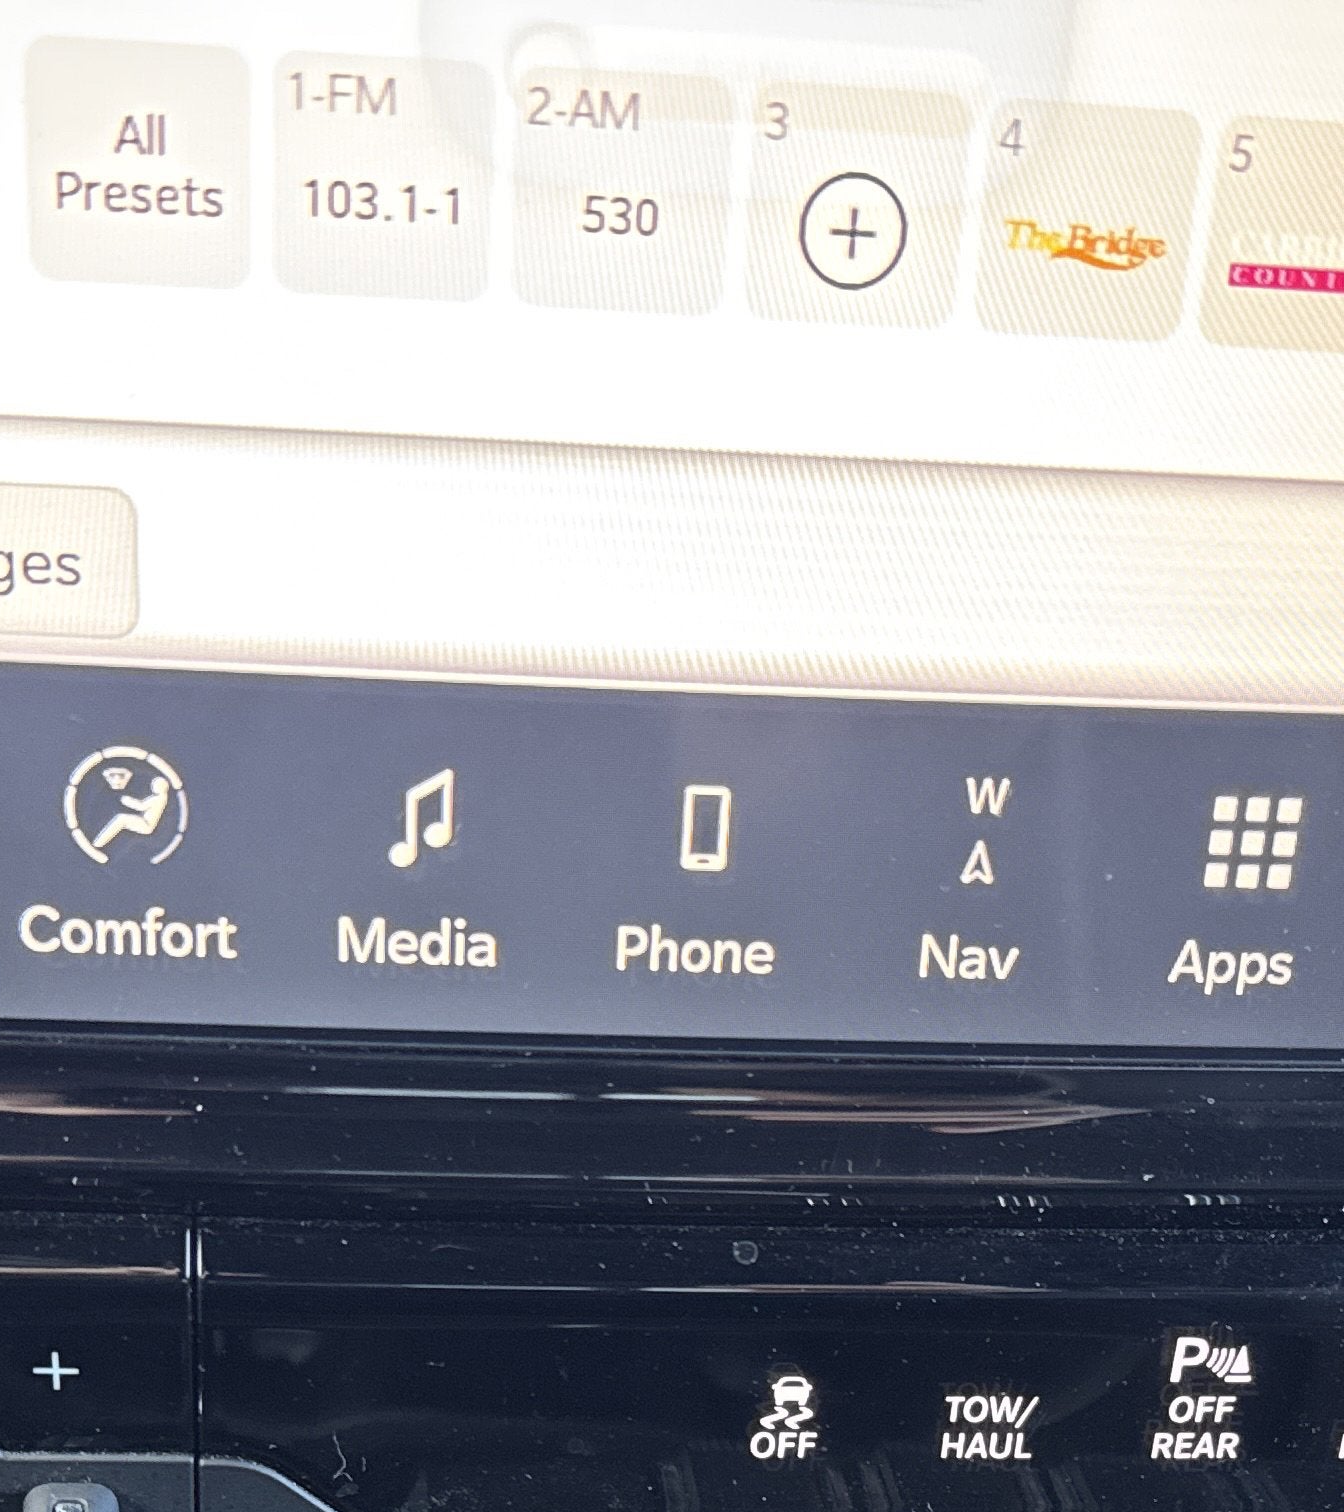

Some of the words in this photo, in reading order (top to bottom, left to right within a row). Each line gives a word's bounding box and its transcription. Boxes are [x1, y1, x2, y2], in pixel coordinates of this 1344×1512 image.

[289, 72, 398, 117] 1-FM
[526, 86, 641, 132] 2-AM
[113, 114, 166, 156] All
[763, 102, 789, 141] 3
[1000, 118, 1025, 157] 4
[1229, 133, 1254, 173] 5
[56, 171, 225, 218] Presets
[303, 180, 460, 225] 103.1-1
[582, 195, 659, 237] 530
[1005, 217, 1062, 252] The
[1067, 224, 1167, 268] Bridge
[966, 777, 1010, 816] W
[19, 904, 238, 959] Comfort
[338, 916, 497, 967] Media
[616, 923, 775, 975] Phone
[918, 934, 1020, 981] Nav
[1168, 939, 1293, 995] Apps
[945, 1396, 1039, 1429] TOW/
[1168, 1396, 1237, 1423] OFF
[750, 1431, 817, 1459] OFF
[940, 1434, 1032, 1459] HAUL
[1151, 1433, 1239, 1459] REAR
